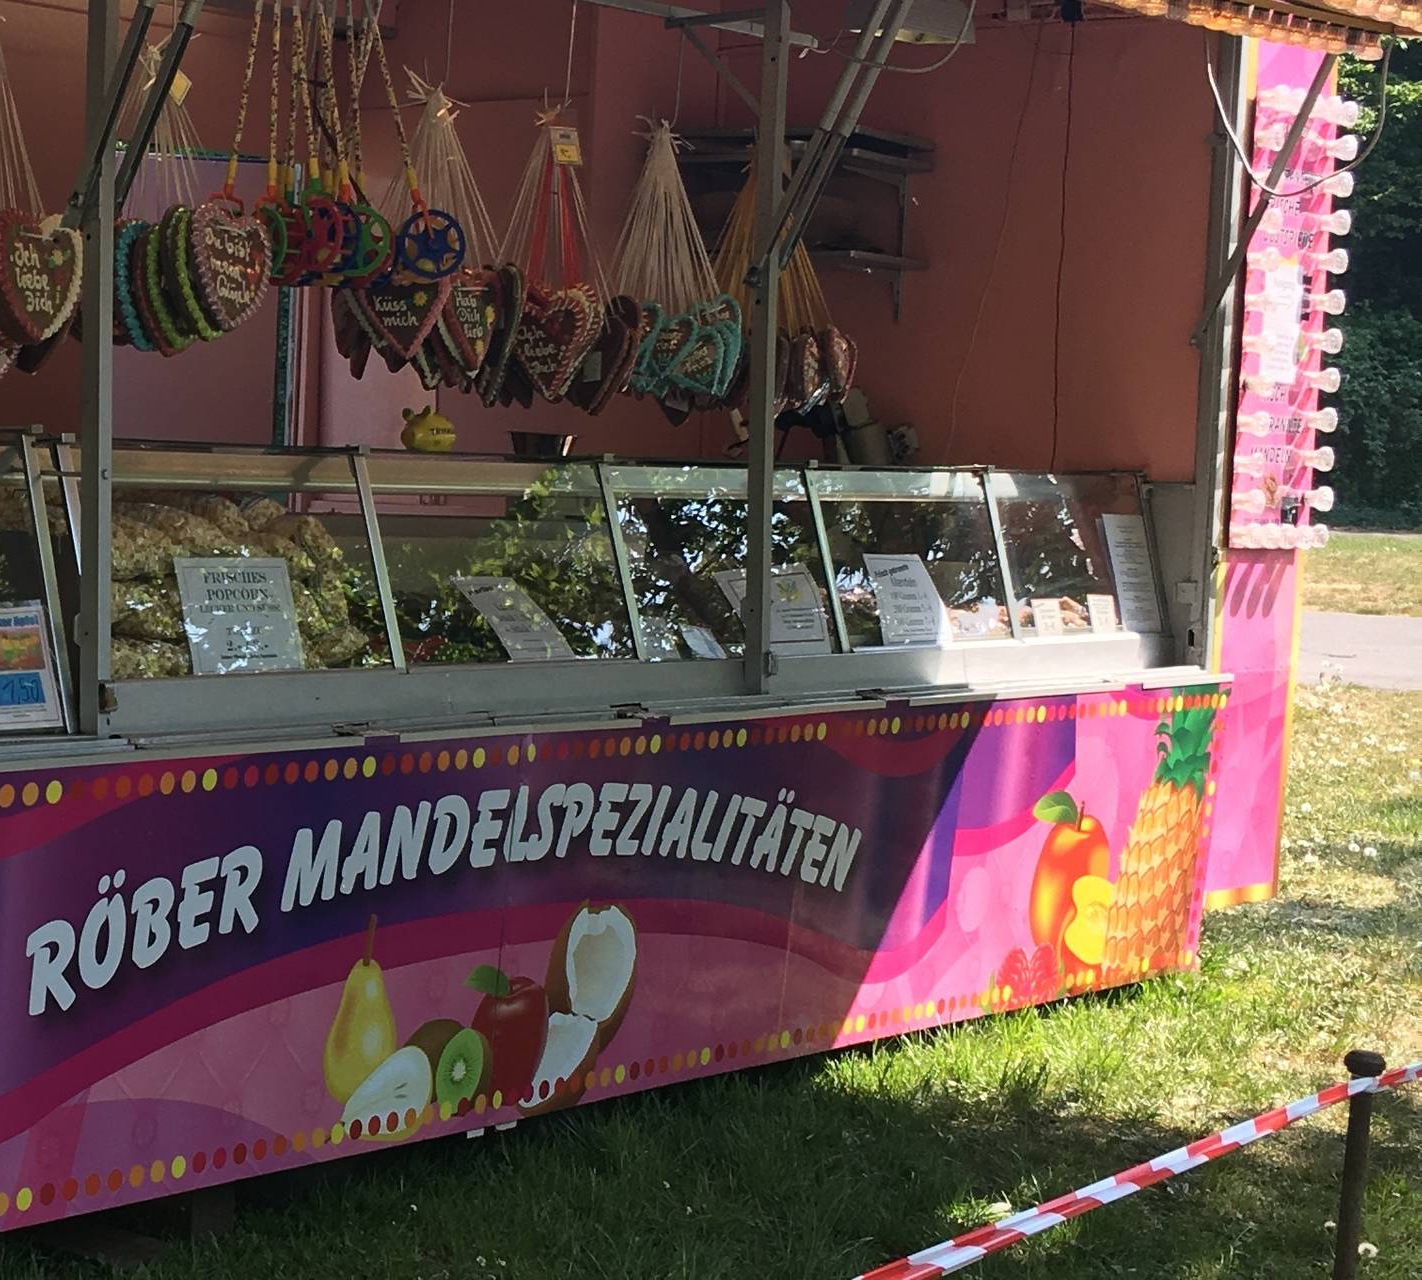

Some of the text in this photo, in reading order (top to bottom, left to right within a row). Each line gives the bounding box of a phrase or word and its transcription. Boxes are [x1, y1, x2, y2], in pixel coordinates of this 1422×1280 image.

[373, 295, 408, 312] Küss
[382, 311, 420, 327] mich
[203, 571, 268, 585] FRISCHES
[2, 679, 39, 705] 1,50
[24, 782, 862, 1017] RÖBER MANDELSPEZIALITÄTEN
